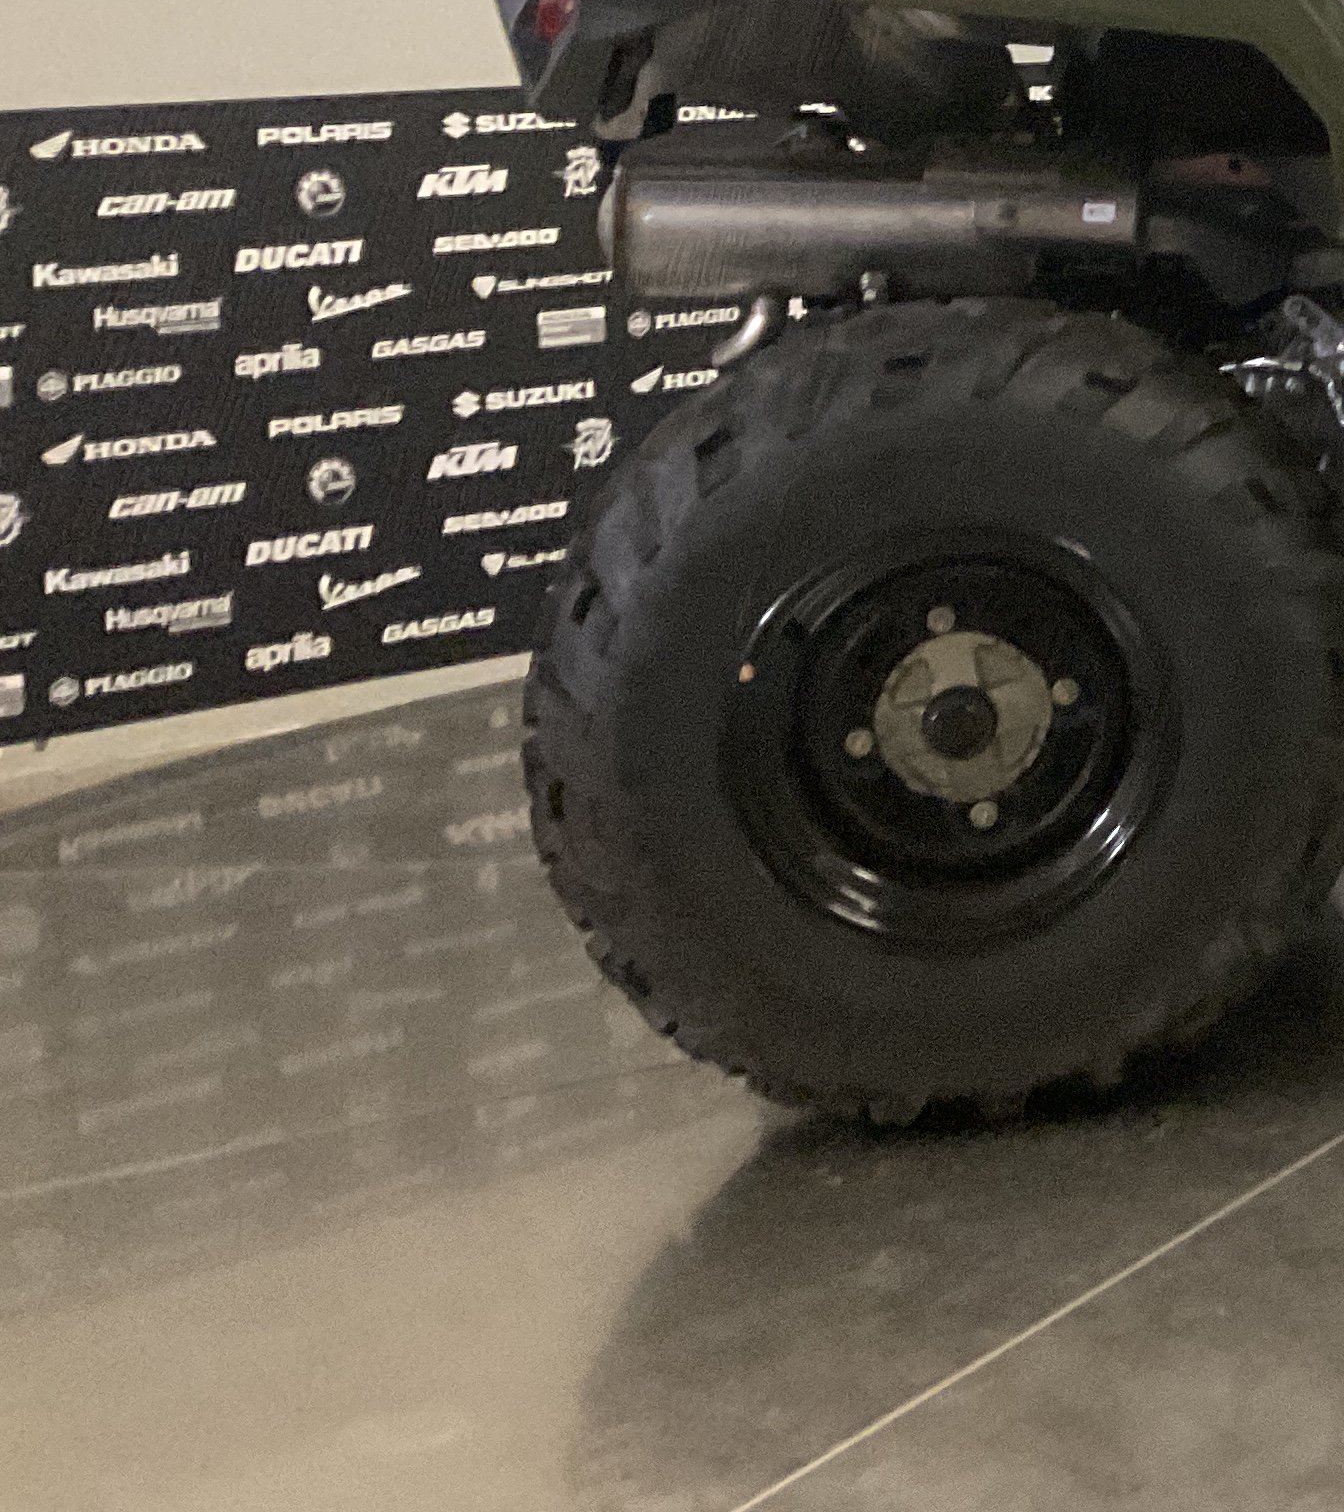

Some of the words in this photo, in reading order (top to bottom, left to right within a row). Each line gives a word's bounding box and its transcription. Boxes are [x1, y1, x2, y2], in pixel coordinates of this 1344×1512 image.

[257, 120, 393, 147] POLARIS
[474, 112, 577, 134] SUZ
[71, 132, 206, 158] HONDA
[416, 163, 509, 199] KTM
[96, 188, 236, 217] can-am
[32, 252, 179, 288] Kawasaki
[234, 238, 364, 273] DUCATI
[654, 306, 741, 330] PIAGGIO
[234, 342, 321, 380] aprilia
[371, 329, 486, 359] GASGAS
[72, 364, 182, 393] PIAGGIO
[485, 380, 595, 411] SUZUKI
[661, 369, 719, 389] HON
[268, 404, 405, 439] POLARIS
[82, 429, 218, 462] HONDA
[426, 441, 518, 481] KTM
[108, 481, 247, 520] can-am
[245, 524, 374, 567] DUCATI
[44, 550, 191, 595] Kawasaki
[381, 607, 496, 644] GASGAS
[245, 632, 332, 672] aprilia
[84, 662, 194, 697] PIAGGIO
